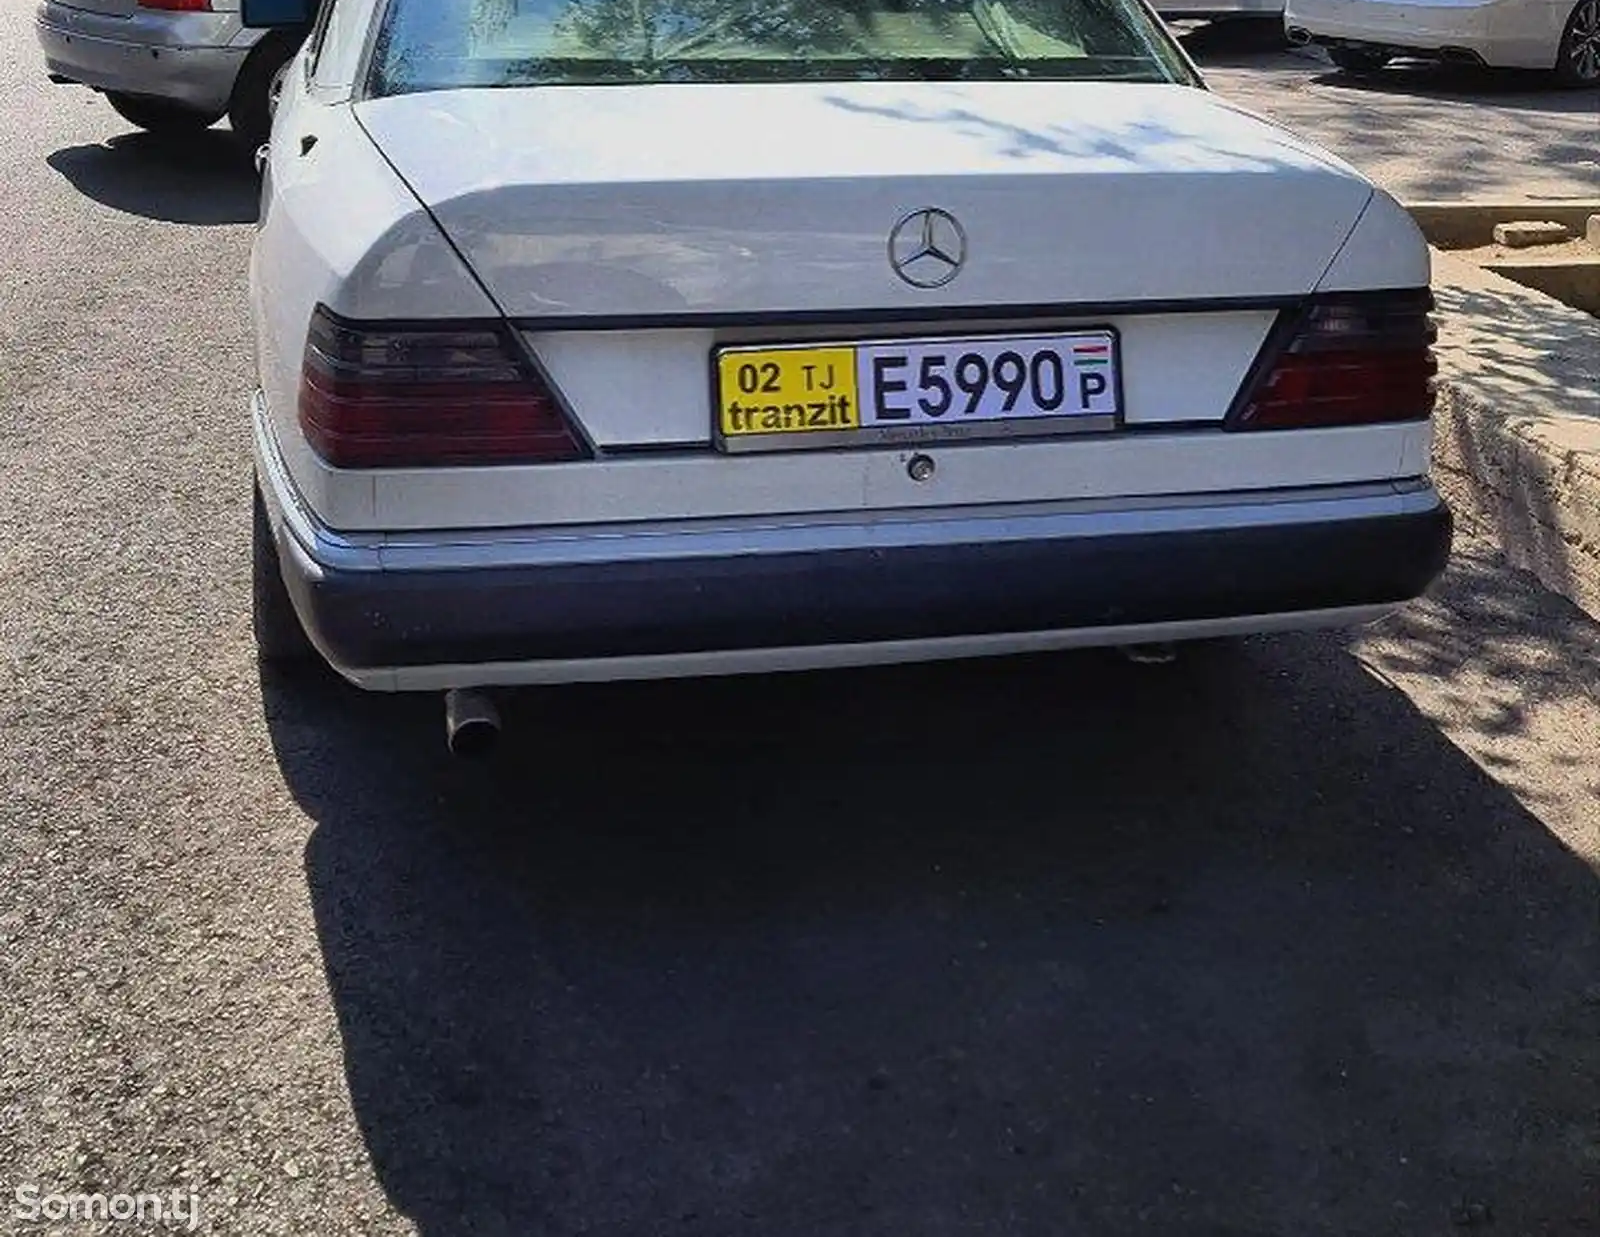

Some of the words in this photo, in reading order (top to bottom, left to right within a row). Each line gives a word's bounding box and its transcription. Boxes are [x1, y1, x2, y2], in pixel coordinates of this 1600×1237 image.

[737, 362, 782, 394] 02
[801, 364, 836, 391] TJ
[873, 349, 1066, 421] E5990
[1080, 372, 1107, 409] P
[728, 395, 852, 431] tranzit
